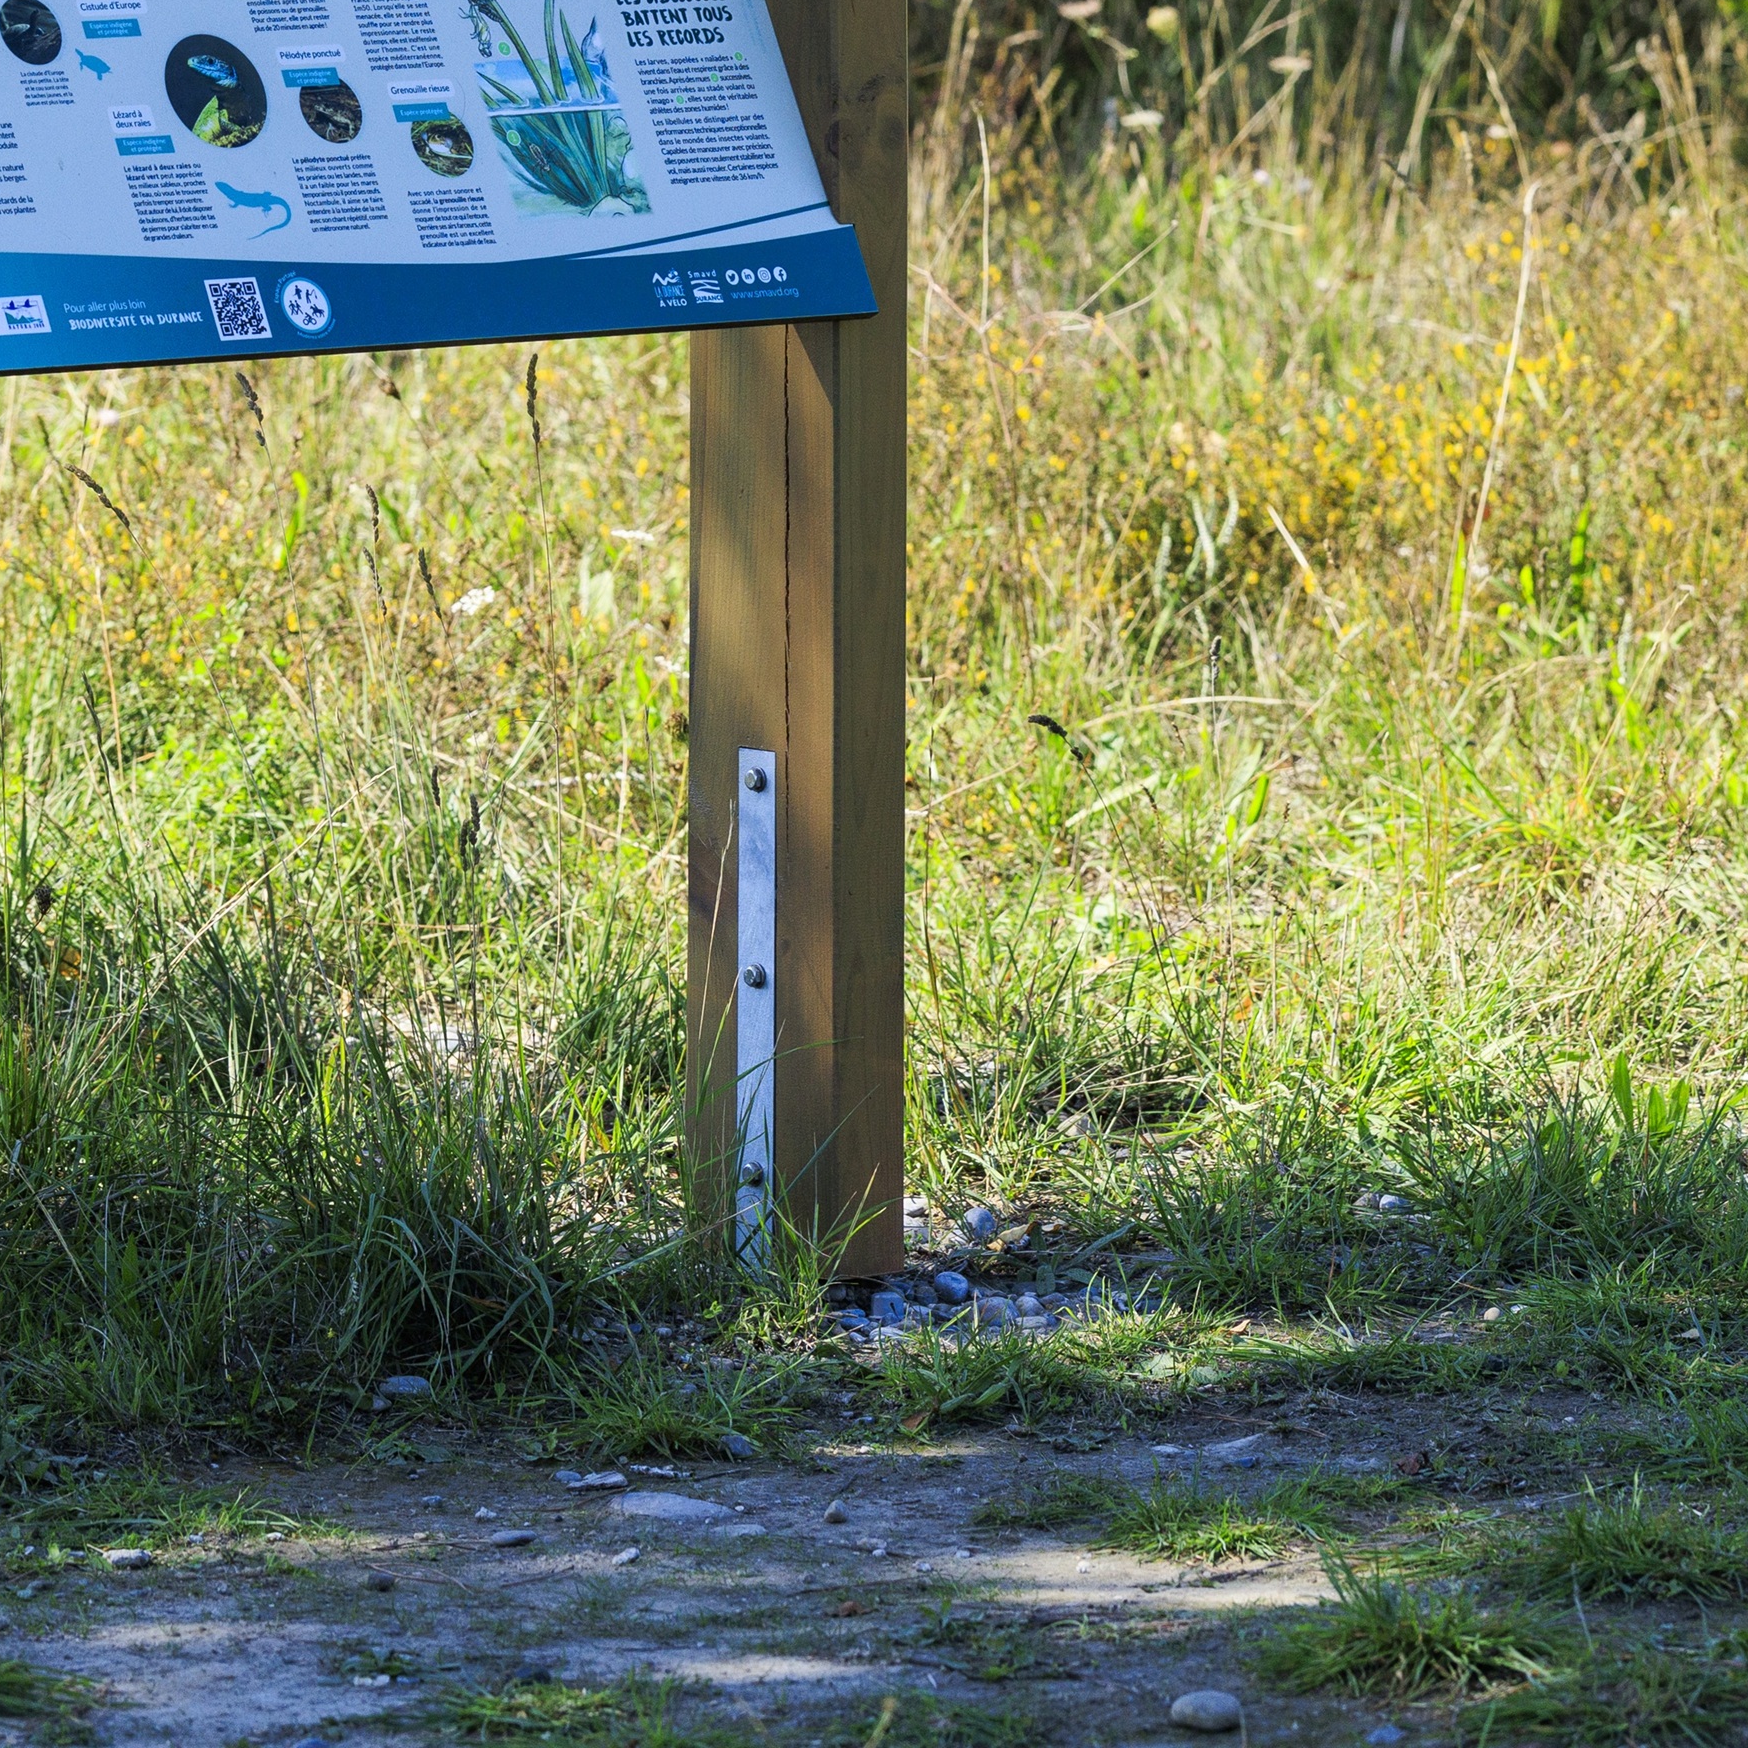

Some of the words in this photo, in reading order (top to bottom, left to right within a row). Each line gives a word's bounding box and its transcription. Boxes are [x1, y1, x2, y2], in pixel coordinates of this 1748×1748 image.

[79, 2, 108, 11] Cistude
[108, 1, 141, 9] d'Europe
[621, 8, 687, 26] BATTENT
[693, 5, 732, 22] TOUS
[626, 30, 653, 47] LES
[657, 26, 724, 45] RECORDS
[279, 51, 311, 59] Pélodyte
[311, 49, 340, 58] ponctué
[390, 85, 427, 94] Grenouille
[428, 84, 449, 92] rieuse
[112, 110, 137, 118] Lézard
[115, 120, 133, 128] deux
[664, 117, 693, 125] libellules
[703, 115, 739, 123] distinguent
[681, 136, 704, 144] monde
[687, 269, 717, 279] Smavd
[730, 286, 800, 299] www.smavd.org
[63, 302, 85, 313] Pour
[87, 301, 106, 311] aller
[108, 300, 127, 312] plus
[127, 299, 146, 309] loin
[659, 297, 667, 308] À
[666, 296, 688, 308] VÉLO
[69, 315, 136, 329] BIODIVERSITÉ
[139, 315, 154, 325] EN
[156, 311, 202, 324] DURANCE
